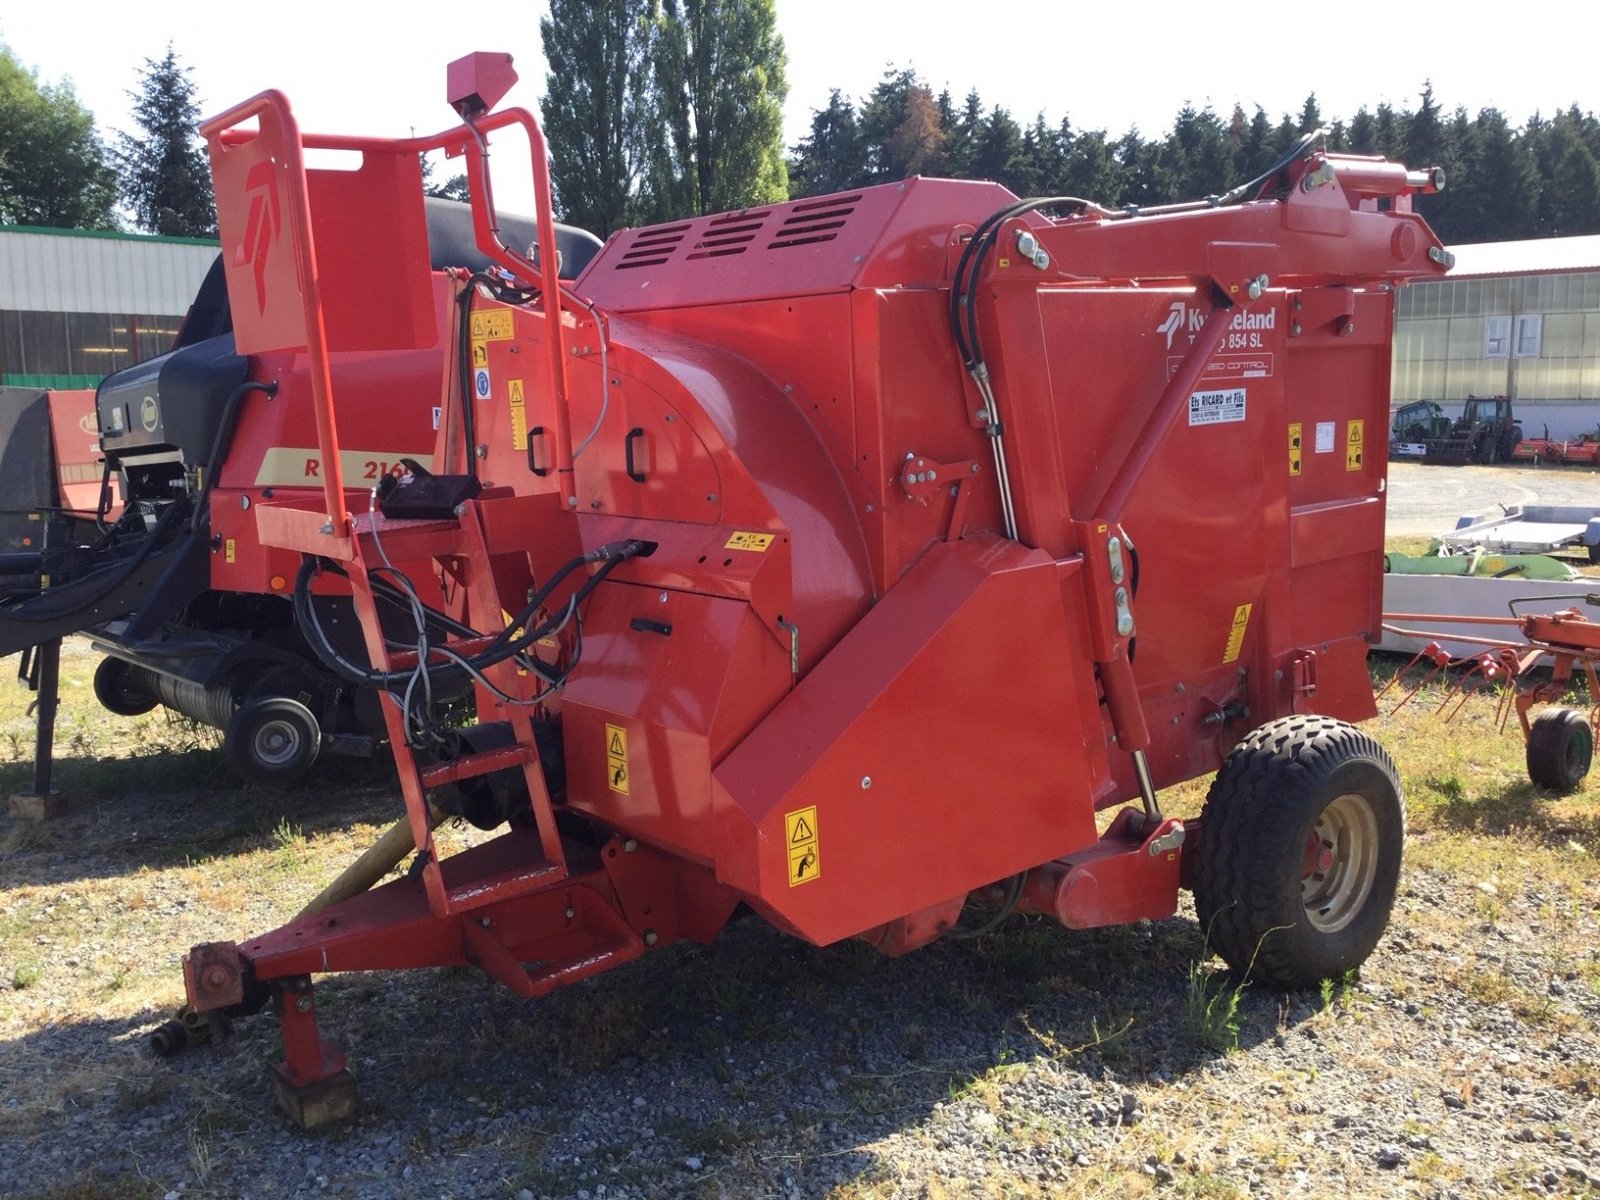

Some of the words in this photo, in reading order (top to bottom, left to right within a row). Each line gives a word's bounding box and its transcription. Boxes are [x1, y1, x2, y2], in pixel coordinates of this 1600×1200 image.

[1188, 307, 1276, 332] Kveland
[1228, 333, 1247, 348] 854
[1249, 332, 1263, 347] SL
[1191, 396, 1200, 408] Ets
[1201, 394, 1224, 407] RICARD
[1225, 394, 1232, 404] et
[1234, 392, 1244, 404] Fils
[363, 460, 410, 480] 216
